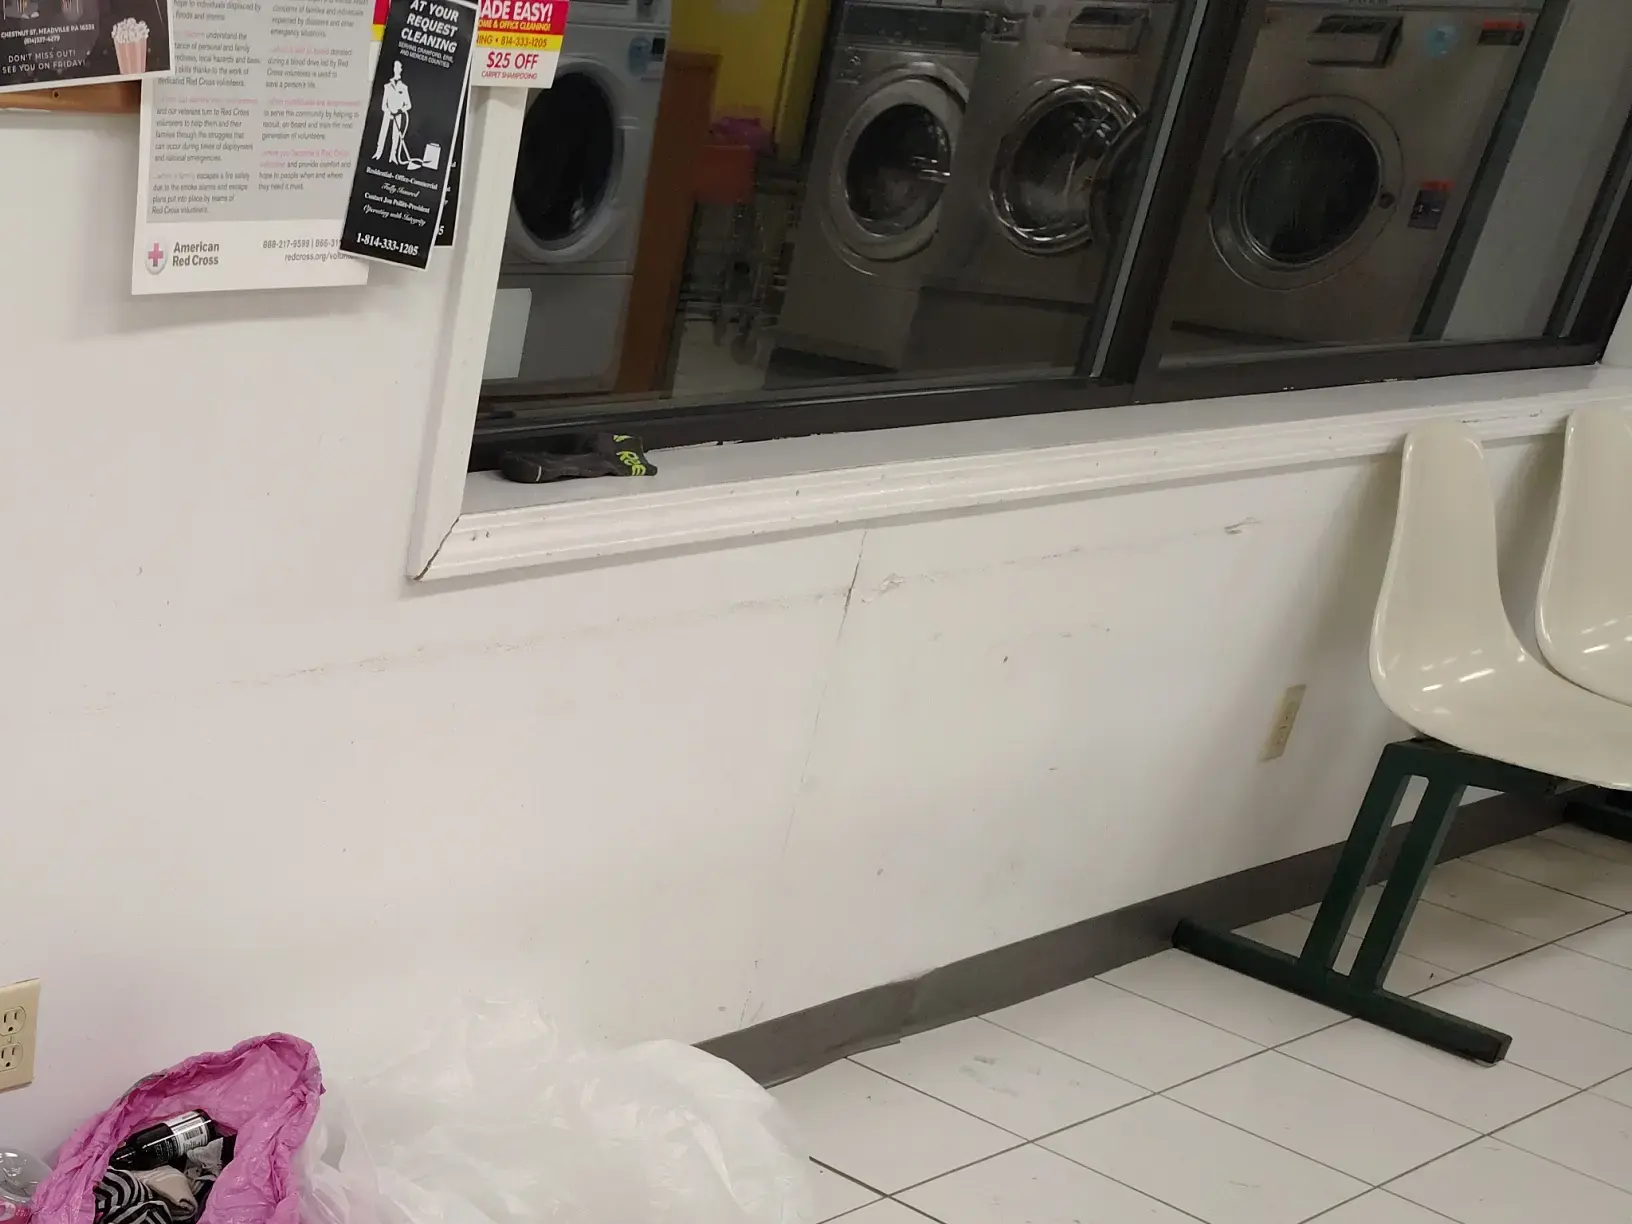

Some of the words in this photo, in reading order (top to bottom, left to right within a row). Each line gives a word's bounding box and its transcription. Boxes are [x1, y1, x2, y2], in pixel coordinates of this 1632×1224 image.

[410, 0, 427, 12] AT
[429, 3, 459, 22] YOUR
[479, 0, 511, 20] ADE
[513, 2, 552, 22] EASY!
[407, 13, 458, 37] REQUEST
[478, 19, 492, 29] OME
[401, 28, 457, 53] CLEANING
[501, 36, 547, 48] 814-333-1205
[8, 53, 32, 63] DON'T
[35, 52, 54, 60] MISS
[487, 51, 511, 68] $25
[515, 53, 539, 69] OFF
[2, 66, 16, 74] SEE
[19, 63, 35, 72] YOU
[53, 59, 85, 68] FRIDAY!
[173, 242, 220, 253] American
[356, 232, 419, 256] 1-814-333-1205
[172, 256, 190, 267] Red
[192, 255, 219, 266] Cross
